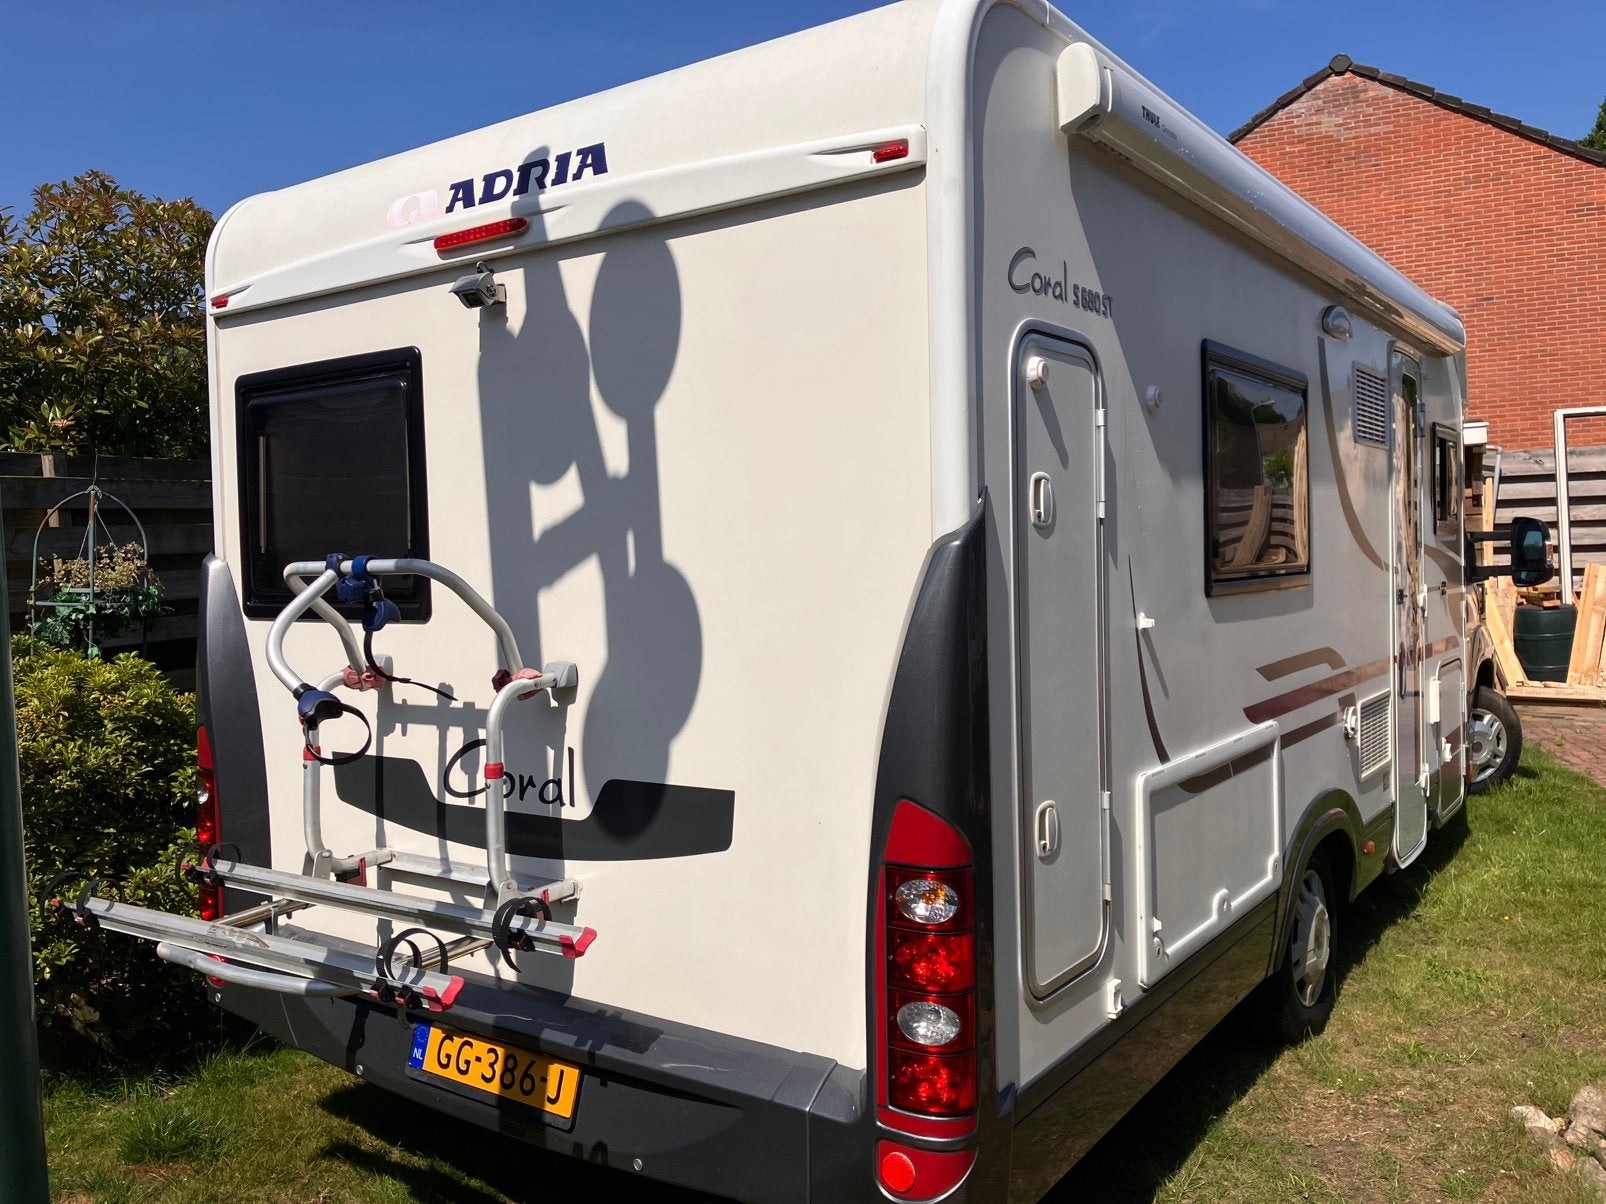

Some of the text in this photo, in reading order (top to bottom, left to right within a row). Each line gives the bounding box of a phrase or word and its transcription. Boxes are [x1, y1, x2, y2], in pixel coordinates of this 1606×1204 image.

[1141, 105, 1161, 129] THULE
[445, 142, 608, 214] ADRIA
[1008, 246, 1069, 304] Coral
[412, 1048, 424, 1061] NL
[436, 1033, 565, 1106] GG-386-J
